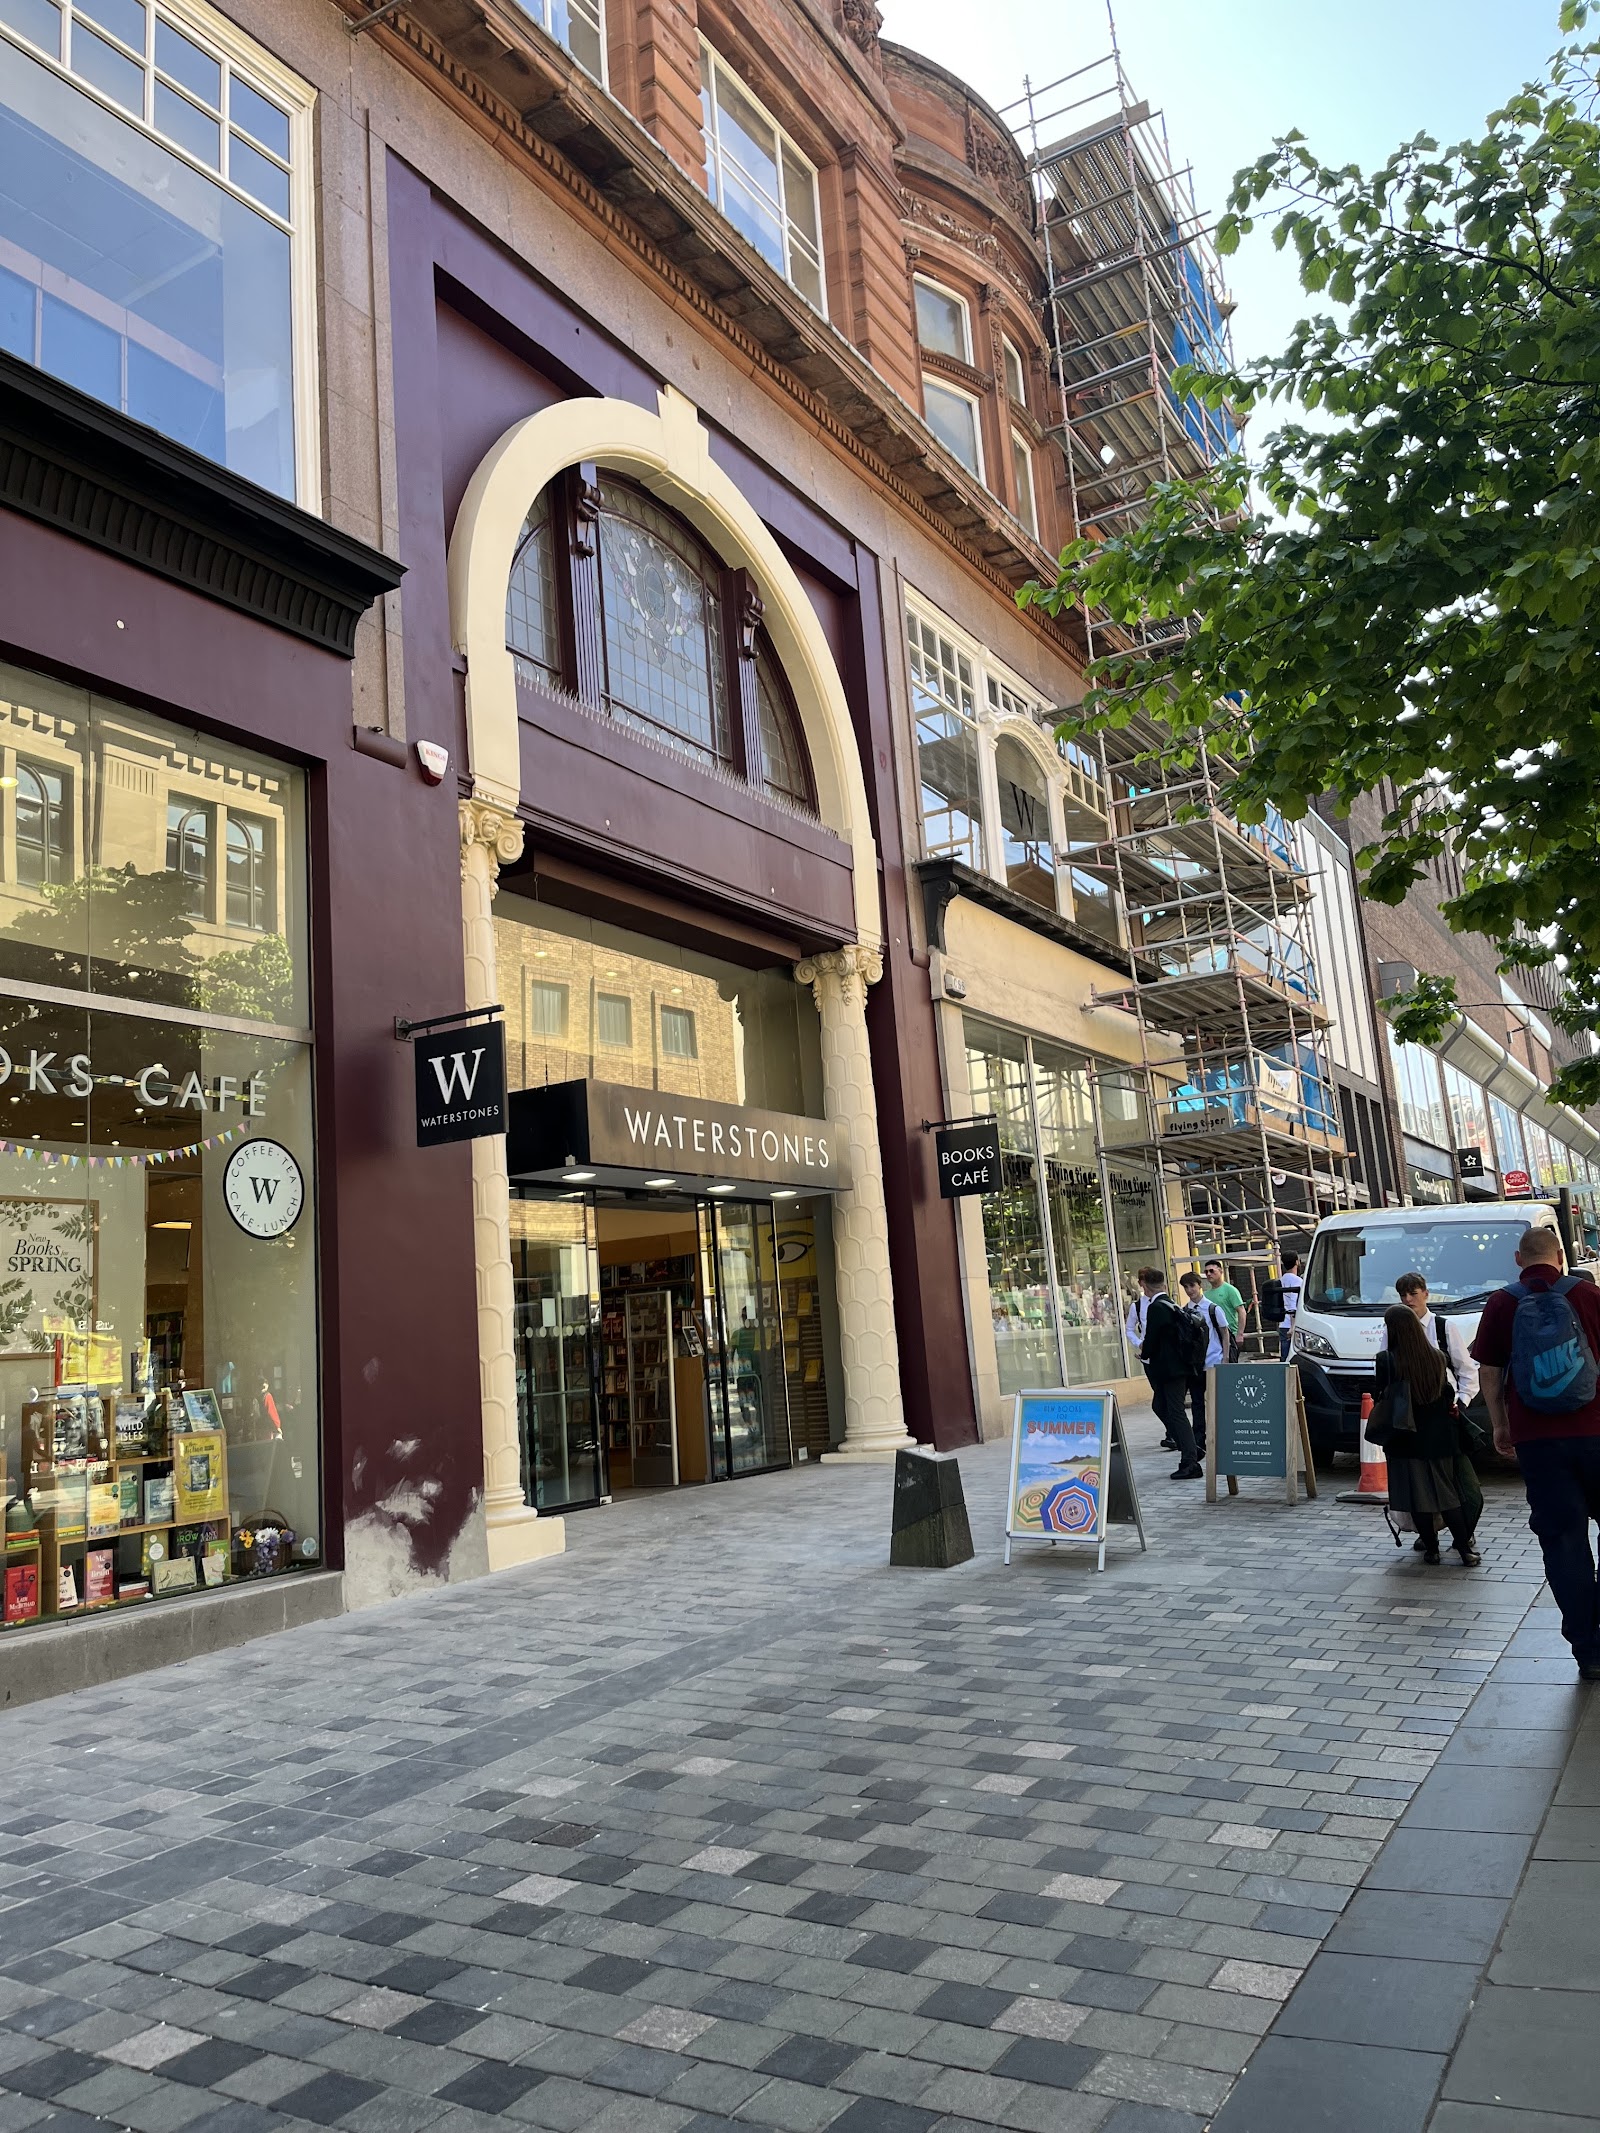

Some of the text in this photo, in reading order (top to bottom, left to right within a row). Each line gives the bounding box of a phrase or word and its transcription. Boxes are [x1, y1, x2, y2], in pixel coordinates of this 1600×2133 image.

[1009, 781, 1036, 836] W
[428, 1047, 486, 1105] W
[140, 1066, 267, 1117] CAFÉ
[421, 1104, 499, 1128] WATERSTONES
[1170, 1121, 1199, 1132] flying
[624, 1107, 829, 1169] WATERSTONES
[231, 1146, 297, 1184] COFFEE TEA
[941, 1145, 995, 1165] BOOKS
[951, 1165, 990, 1187] CAFÉ
[248, 1176, 281, 1204] W
[230, 1191, 299, 1233] CAKE LUNCH
[14, 1239, 62, 1256] Books
[28, 1233, 47, 1243] New
[7, 1256, 82, 1273] SPRING
[1533, 1336, 1582, 1383] NIKE
[1243, 1386, 1258, 1398] W
[119, 1421, 144, 1432] WILD
[120, 1430, 144, 1441] ISLES
[1027, 1420, 1096, 1435] SUMMER
